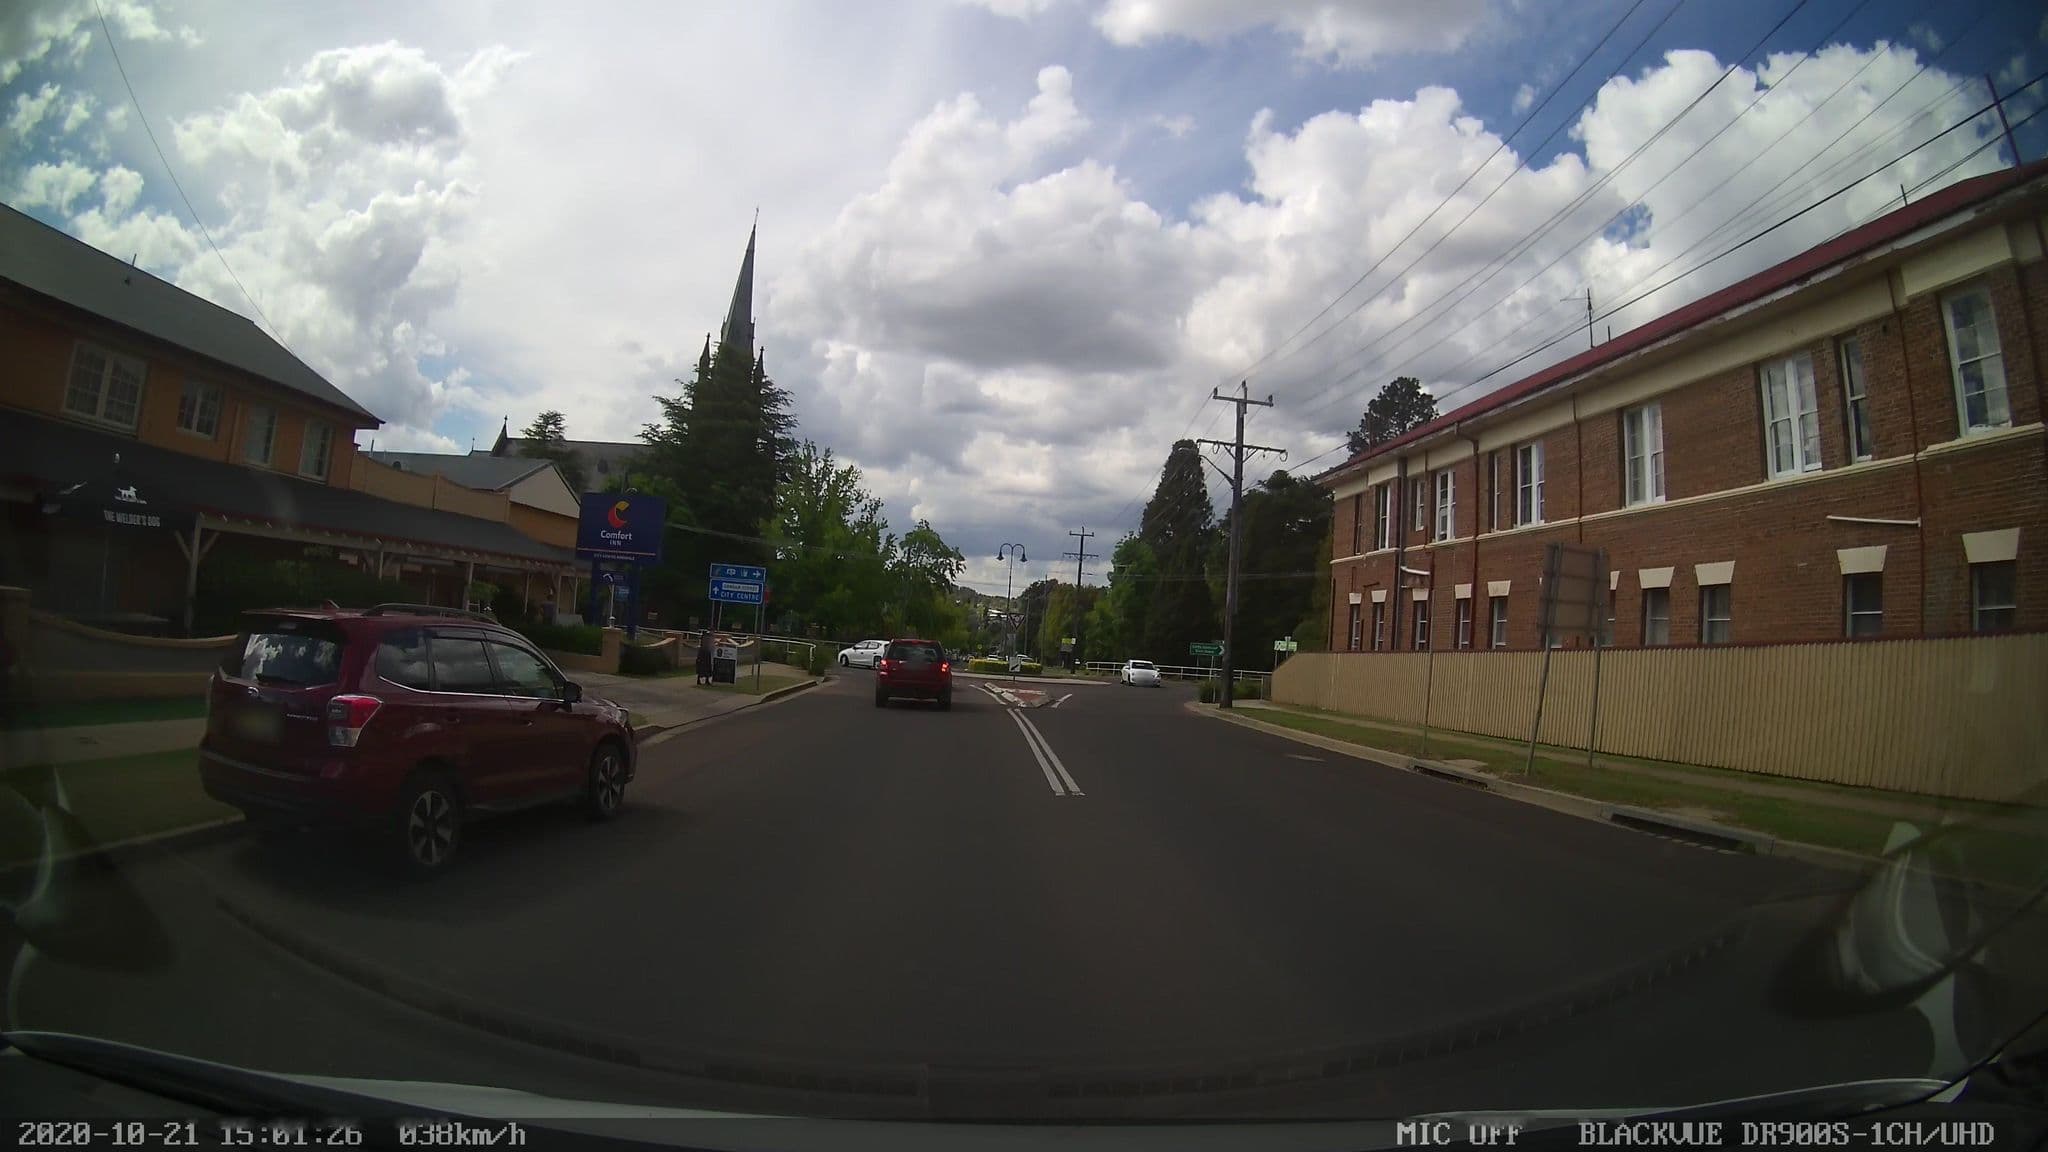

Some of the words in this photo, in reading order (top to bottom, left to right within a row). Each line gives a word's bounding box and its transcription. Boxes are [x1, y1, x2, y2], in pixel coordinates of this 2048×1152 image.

[600, 530, 633, 541] Comfort
[720, 591, 734, 599] CITY
[736, 592, 760, 601] CENTRE
